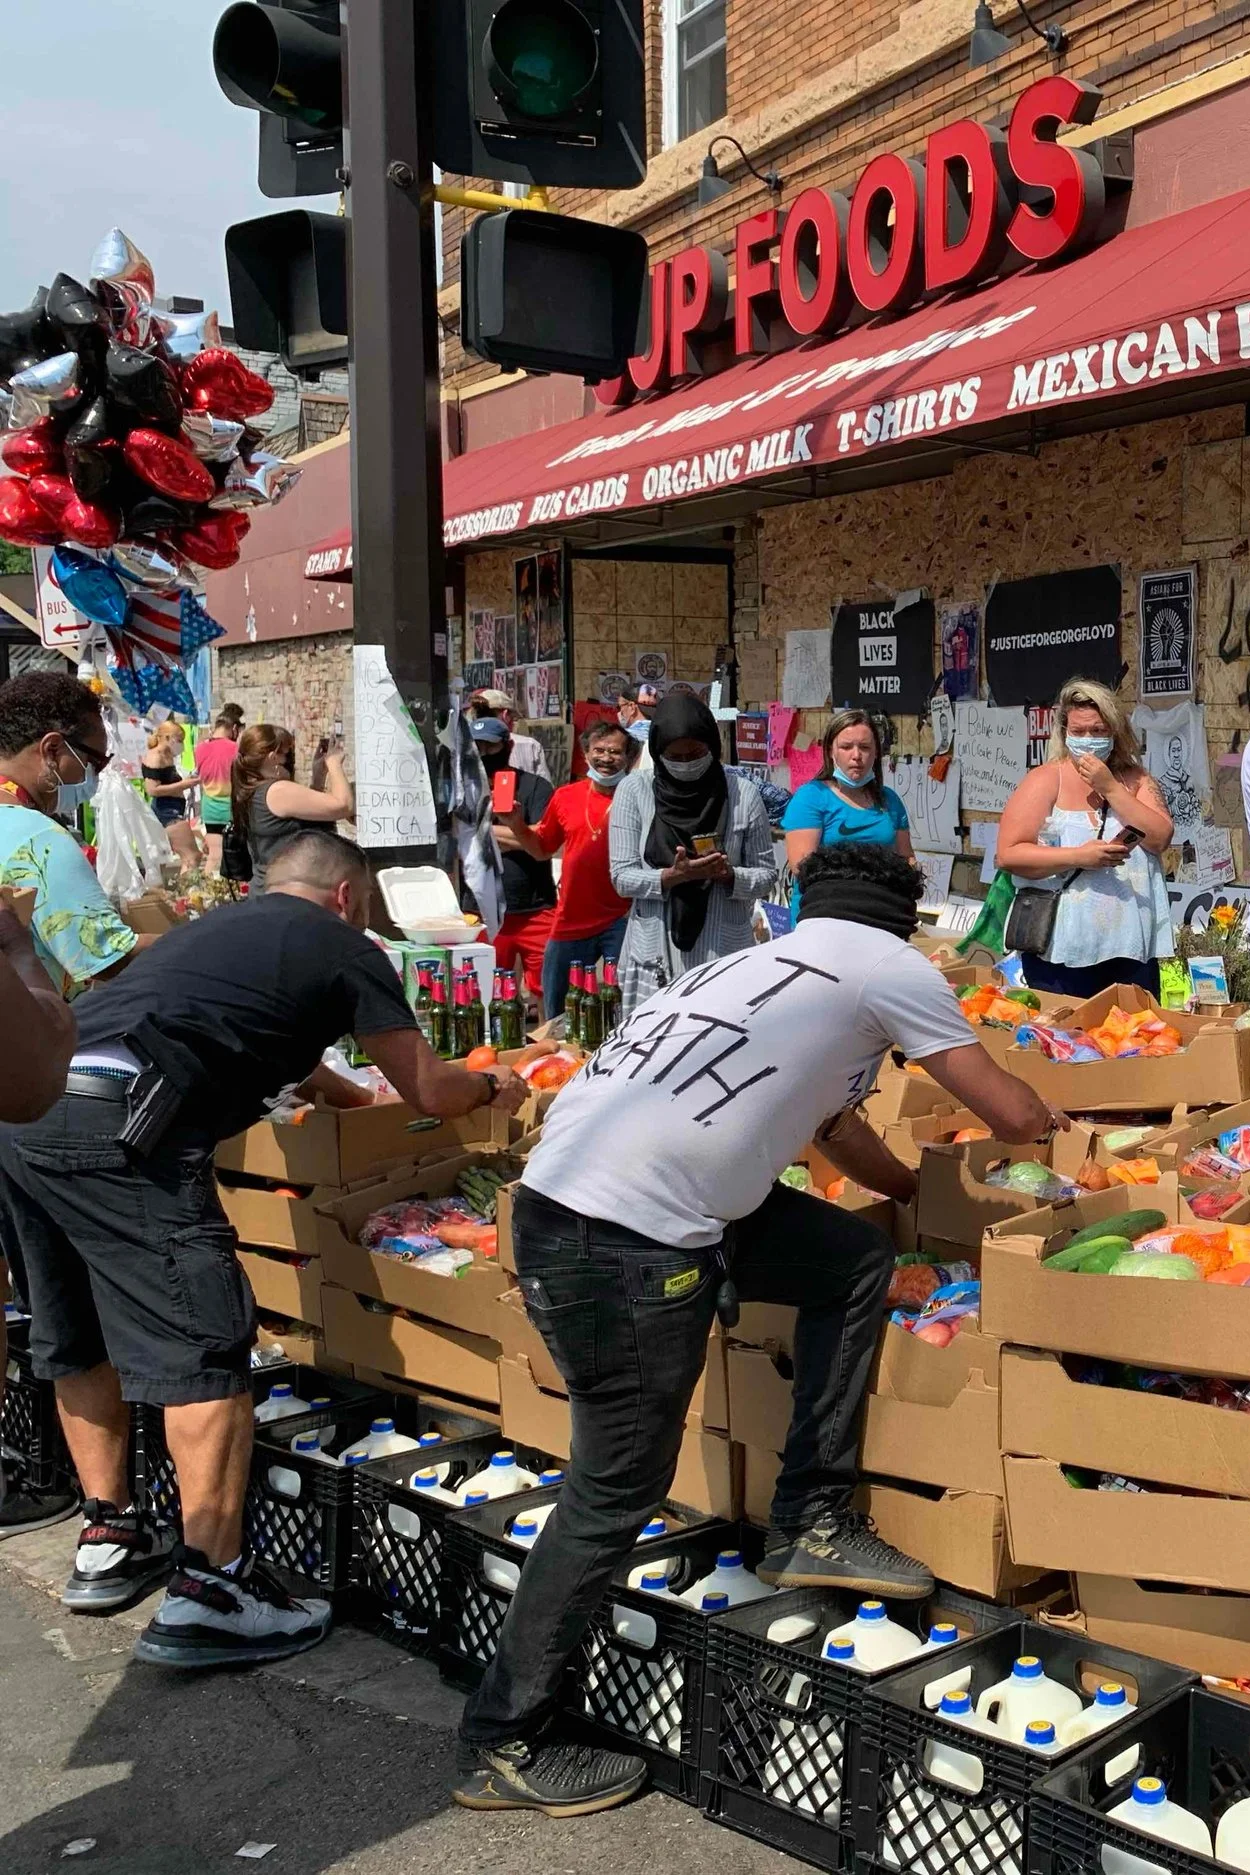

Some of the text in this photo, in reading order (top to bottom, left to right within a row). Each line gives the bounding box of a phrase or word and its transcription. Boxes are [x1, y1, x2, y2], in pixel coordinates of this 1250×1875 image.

[594, 76, 1104, 405] UP FOODS
[785, 306, 1037, 398] Produce
[1007, 311, 1221, 409] MEXICAN
[836, 376, 981, 453] T-SHIRTS
[643, 423, 812, 500] ORGANIC MILK
[528, 473, 629, 524] BUS CARDS
[443, 502, 523, 543] CCESSORIES
[305, 549, 343, 577] STAMPS
[1172, 582, 1184, 593] FOR
[47, 601, 68, 616] BUS
[859, 611, 895, 630] BLACK
[990, 624, 1115, 651] #JUSTICEFORGEORGFLOYD
[863, 644, 893, 662] LIVES
[859, 676, 901, 694] MATTER
[1147, 679, 1186, 692] BLACK LIVES
[1028, 709, 1054, 736] BLA
[359, 791, 434, 808] IDARIDAD
